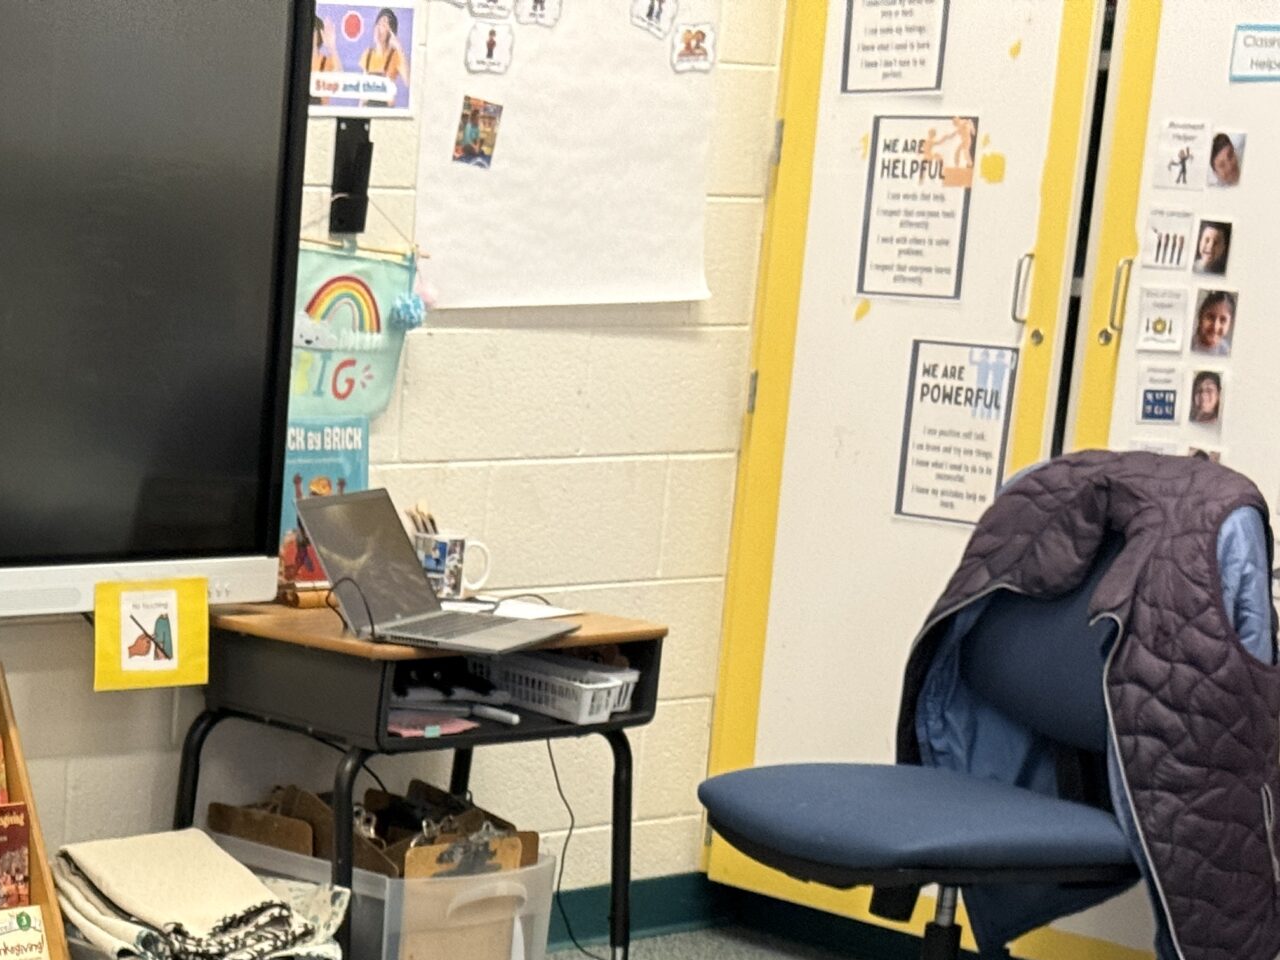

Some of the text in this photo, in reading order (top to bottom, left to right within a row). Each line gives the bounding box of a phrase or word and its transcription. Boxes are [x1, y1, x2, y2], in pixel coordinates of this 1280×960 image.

[315, 80, 387, 94] Stop and think
[883, 139, 925, 154] WE ARE
[880, 158, 945, 181] HELPFUL
[922, 362, 965, 381] WE ARE
[920, 383, 1001, 410] POWERFUL
[324, 426, 362, 451] BRICK
